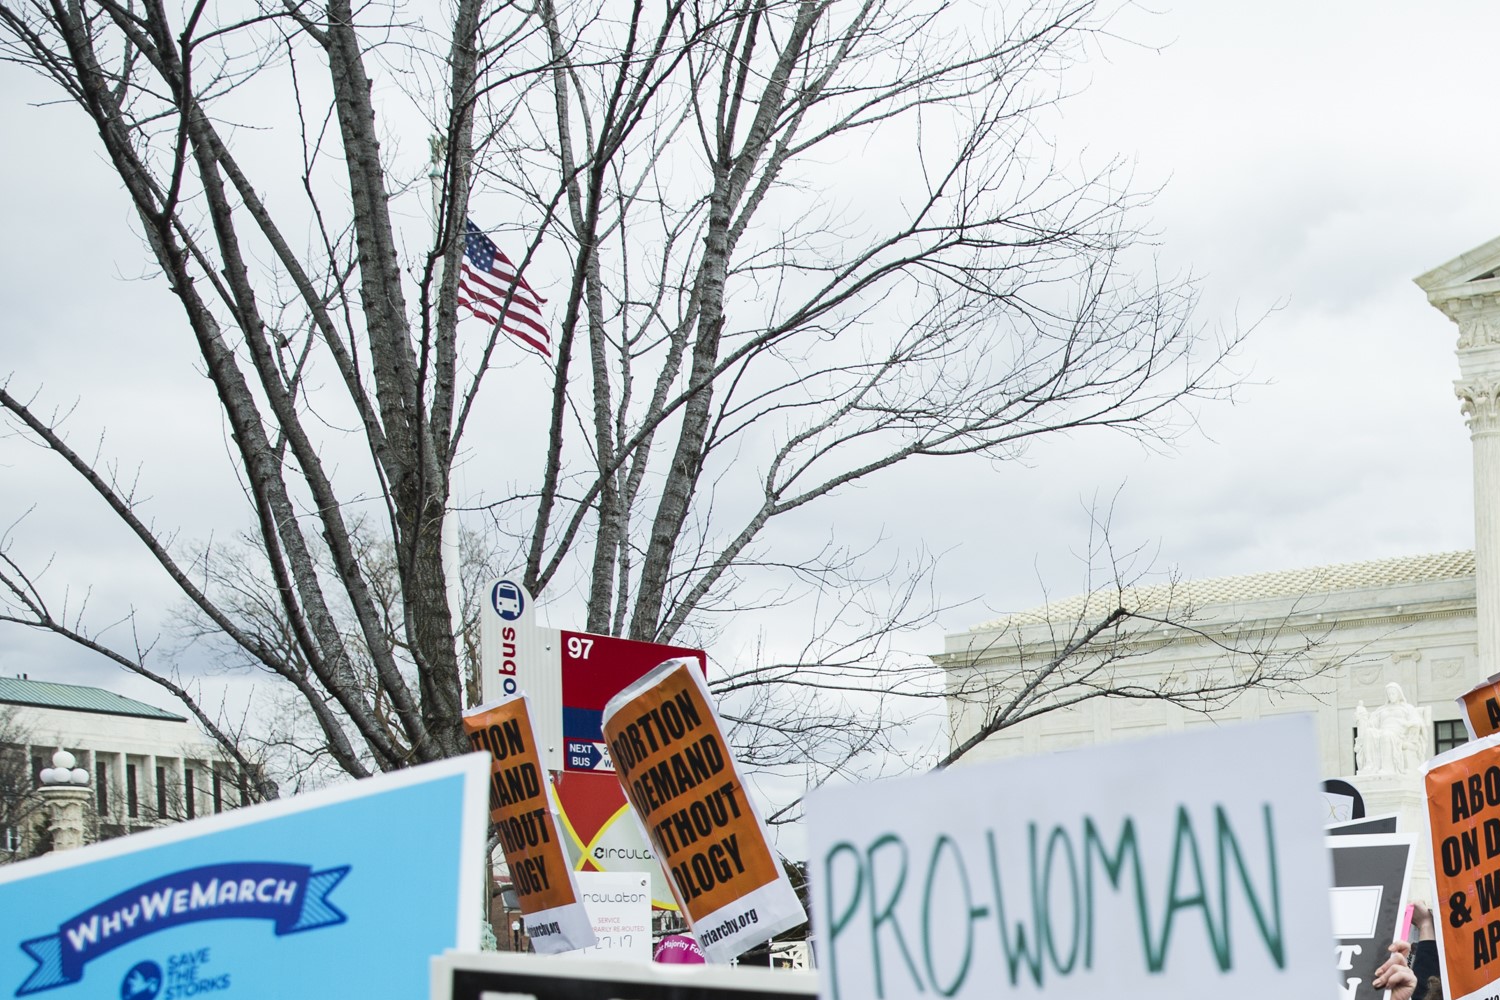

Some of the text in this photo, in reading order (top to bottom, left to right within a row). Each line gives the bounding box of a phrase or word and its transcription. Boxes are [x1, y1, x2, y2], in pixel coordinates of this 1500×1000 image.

[567, 637, 594, 660] 97
[499, 626, 517, 697] obus
[471, 718, 525, 761] TION
[569, 743, 592, 754] NEXT
[572, 756, 591, 767] BUS
[1440, 828, 1480, 878] ON
[1449, 891, 1473, 929] &
[664, 941, 690, 951] Majority
[167, 947, 211, 969] SAVE
[167, 967, 200, 984] THE
